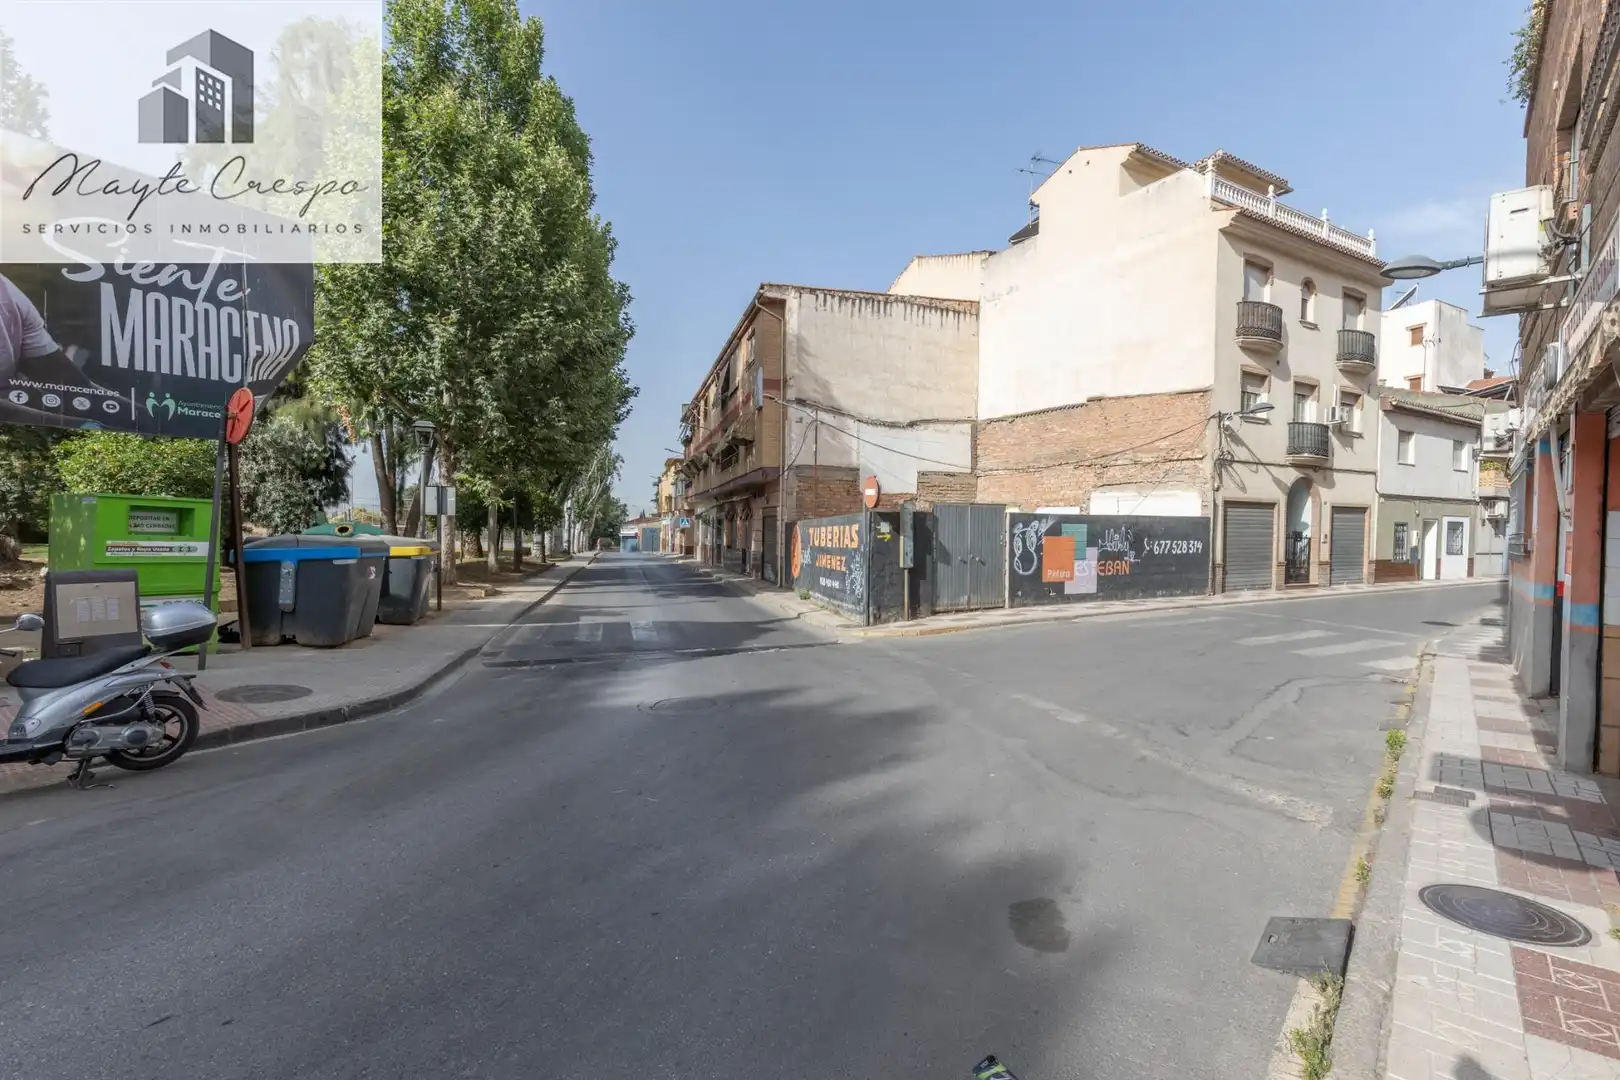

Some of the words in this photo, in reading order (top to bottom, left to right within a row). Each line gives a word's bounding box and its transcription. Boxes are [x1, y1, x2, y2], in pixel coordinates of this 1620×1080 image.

[100, 282, 300, 384] MARACENA
[9, 378, 120, 397] www.maracena.es
[178, 406, 222, 418] Marace
[809, 523, 859, 548] TUBERIAS
[1075, 560, 1130, 576] ESTEBAN
